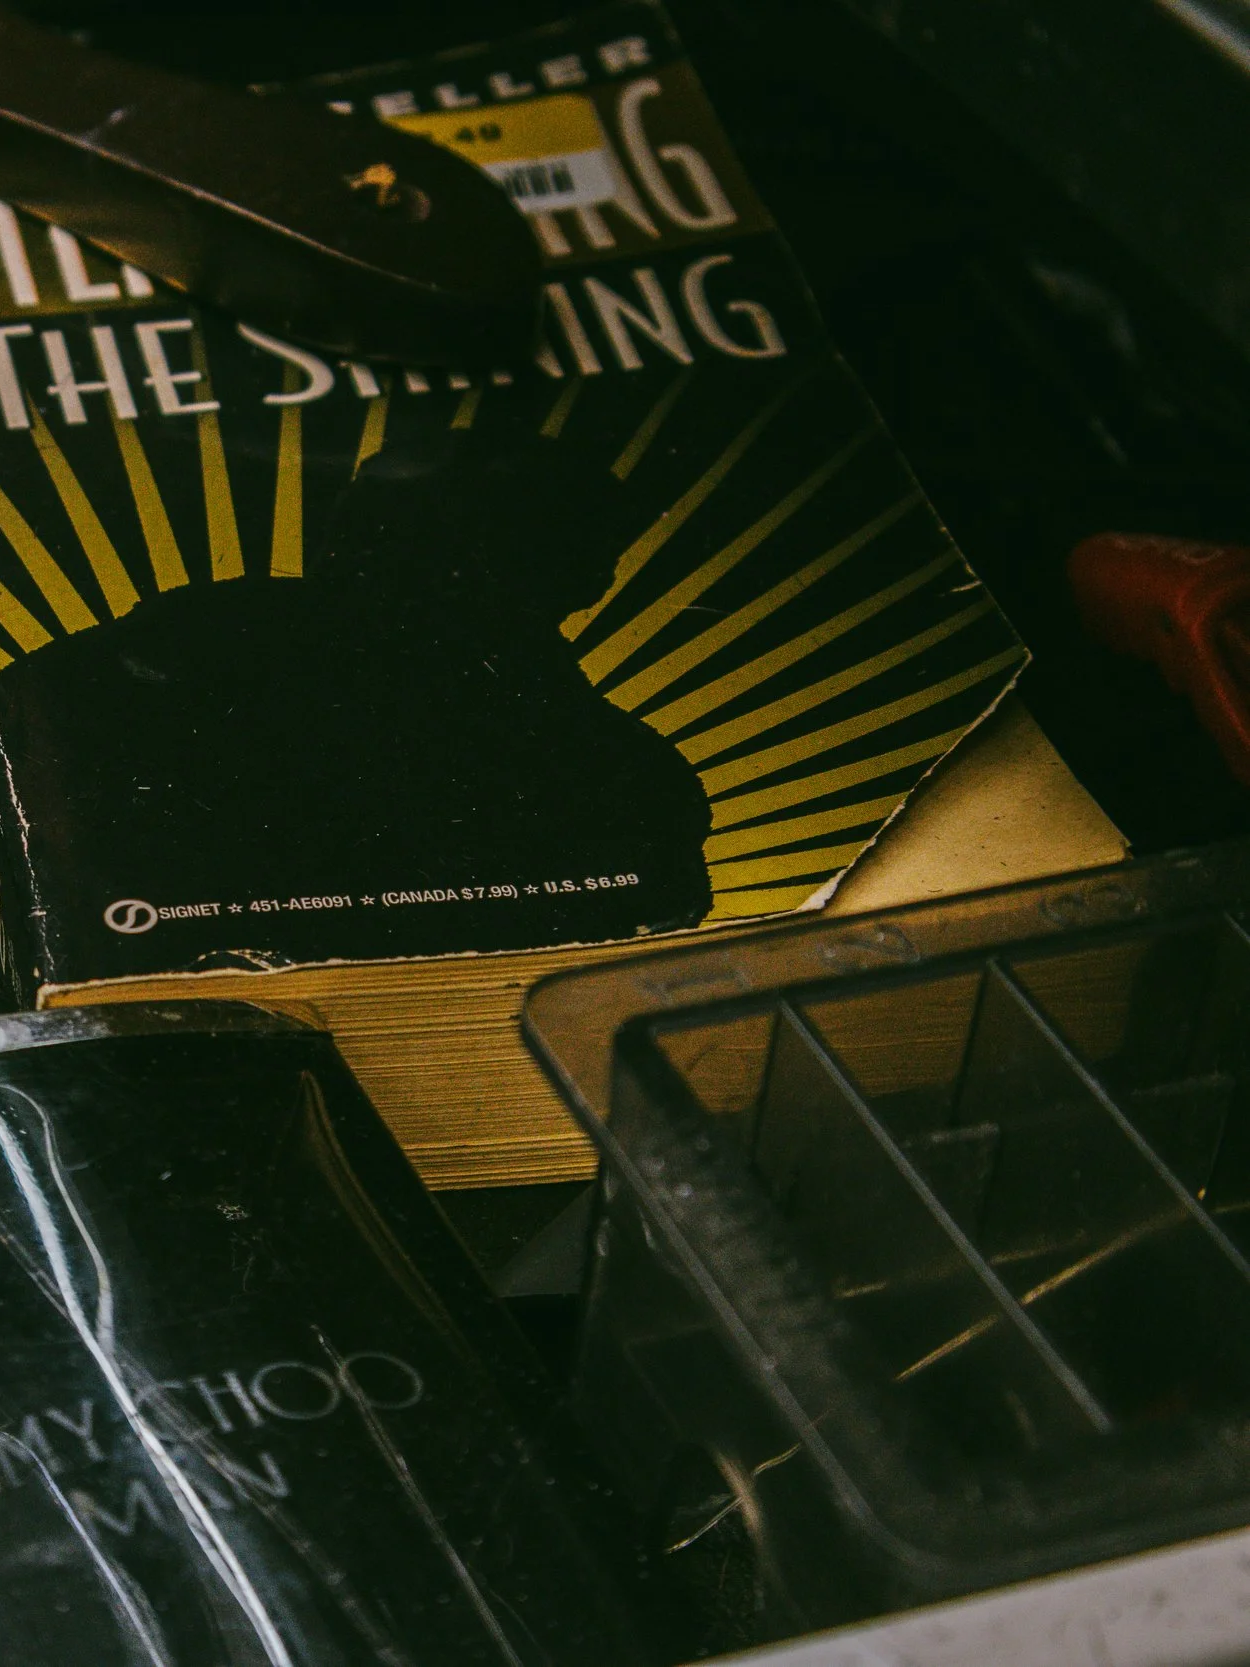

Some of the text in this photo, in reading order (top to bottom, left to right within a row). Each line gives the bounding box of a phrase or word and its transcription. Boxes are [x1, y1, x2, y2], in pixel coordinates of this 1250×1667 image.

[328, 36, 652, 118] ELLER
[237, 254, 787, 404] SING
[158, 873, 639, 920] SIGNET 451-AE6091 (CANADA $7.99) U.S. $6.99
[134, 1350, 425, 1444] CHOO
